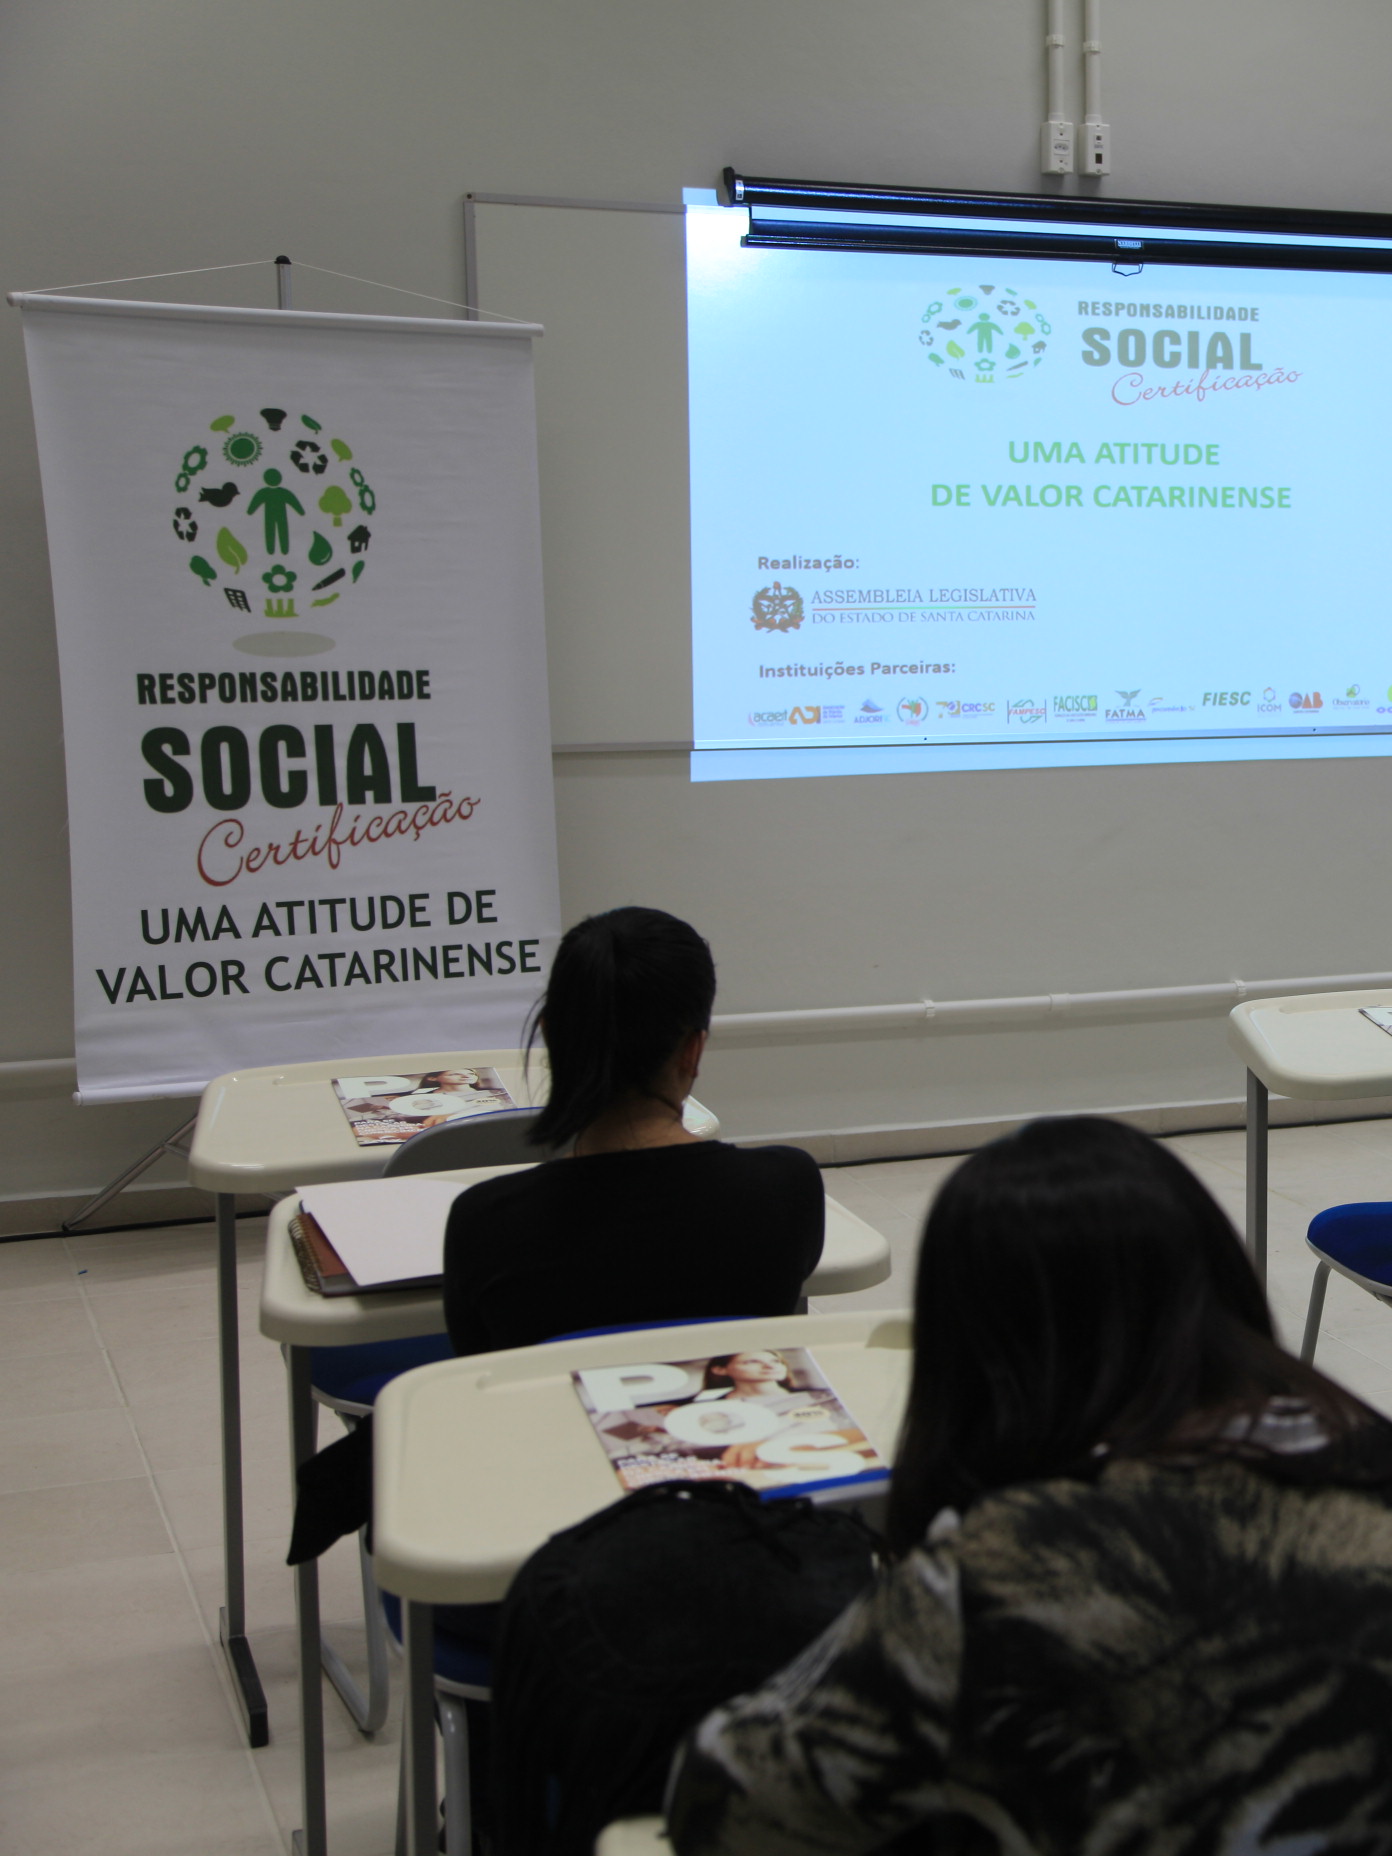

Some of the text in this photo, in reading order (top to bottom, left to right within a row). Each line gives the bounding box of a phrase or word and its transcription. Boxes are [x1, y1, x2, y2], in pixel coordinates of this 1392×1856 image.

[1077, 300, 1260, 322] RESPONSABILIDADE
[1081, 327, 1263, 371] SOCIAL
[1111, 367, 1303, 406] Certificação
[1008, 441, 1220, 466] UMA ATITUDE
[931, 484, 1292, 509] DE VALOR CATARINENSE
[758, 555, 860, 573] Realização:
[811, 588, 1037, 604] ASSEMBLEIA LEGISLATIVA
[812, 610, 1036, 625] DO ESTADO DE SANTA CATARINA
[759, 660, 956, 680] Instituições Parceiras:
[137, 670, 431, 704] RESPONSABILIDADE
[1202, 691, 1251, 706] FIESC
[1105, 709, 1145, 719] FATMA
[141, 722, 437, 813] SOCIAL
[197, 791, 481, 887] Certificação
[140, 889, 498, 945] UMA ATITUDE DE
[95, 939, 541, 1005] VALOR CATARINENSE
